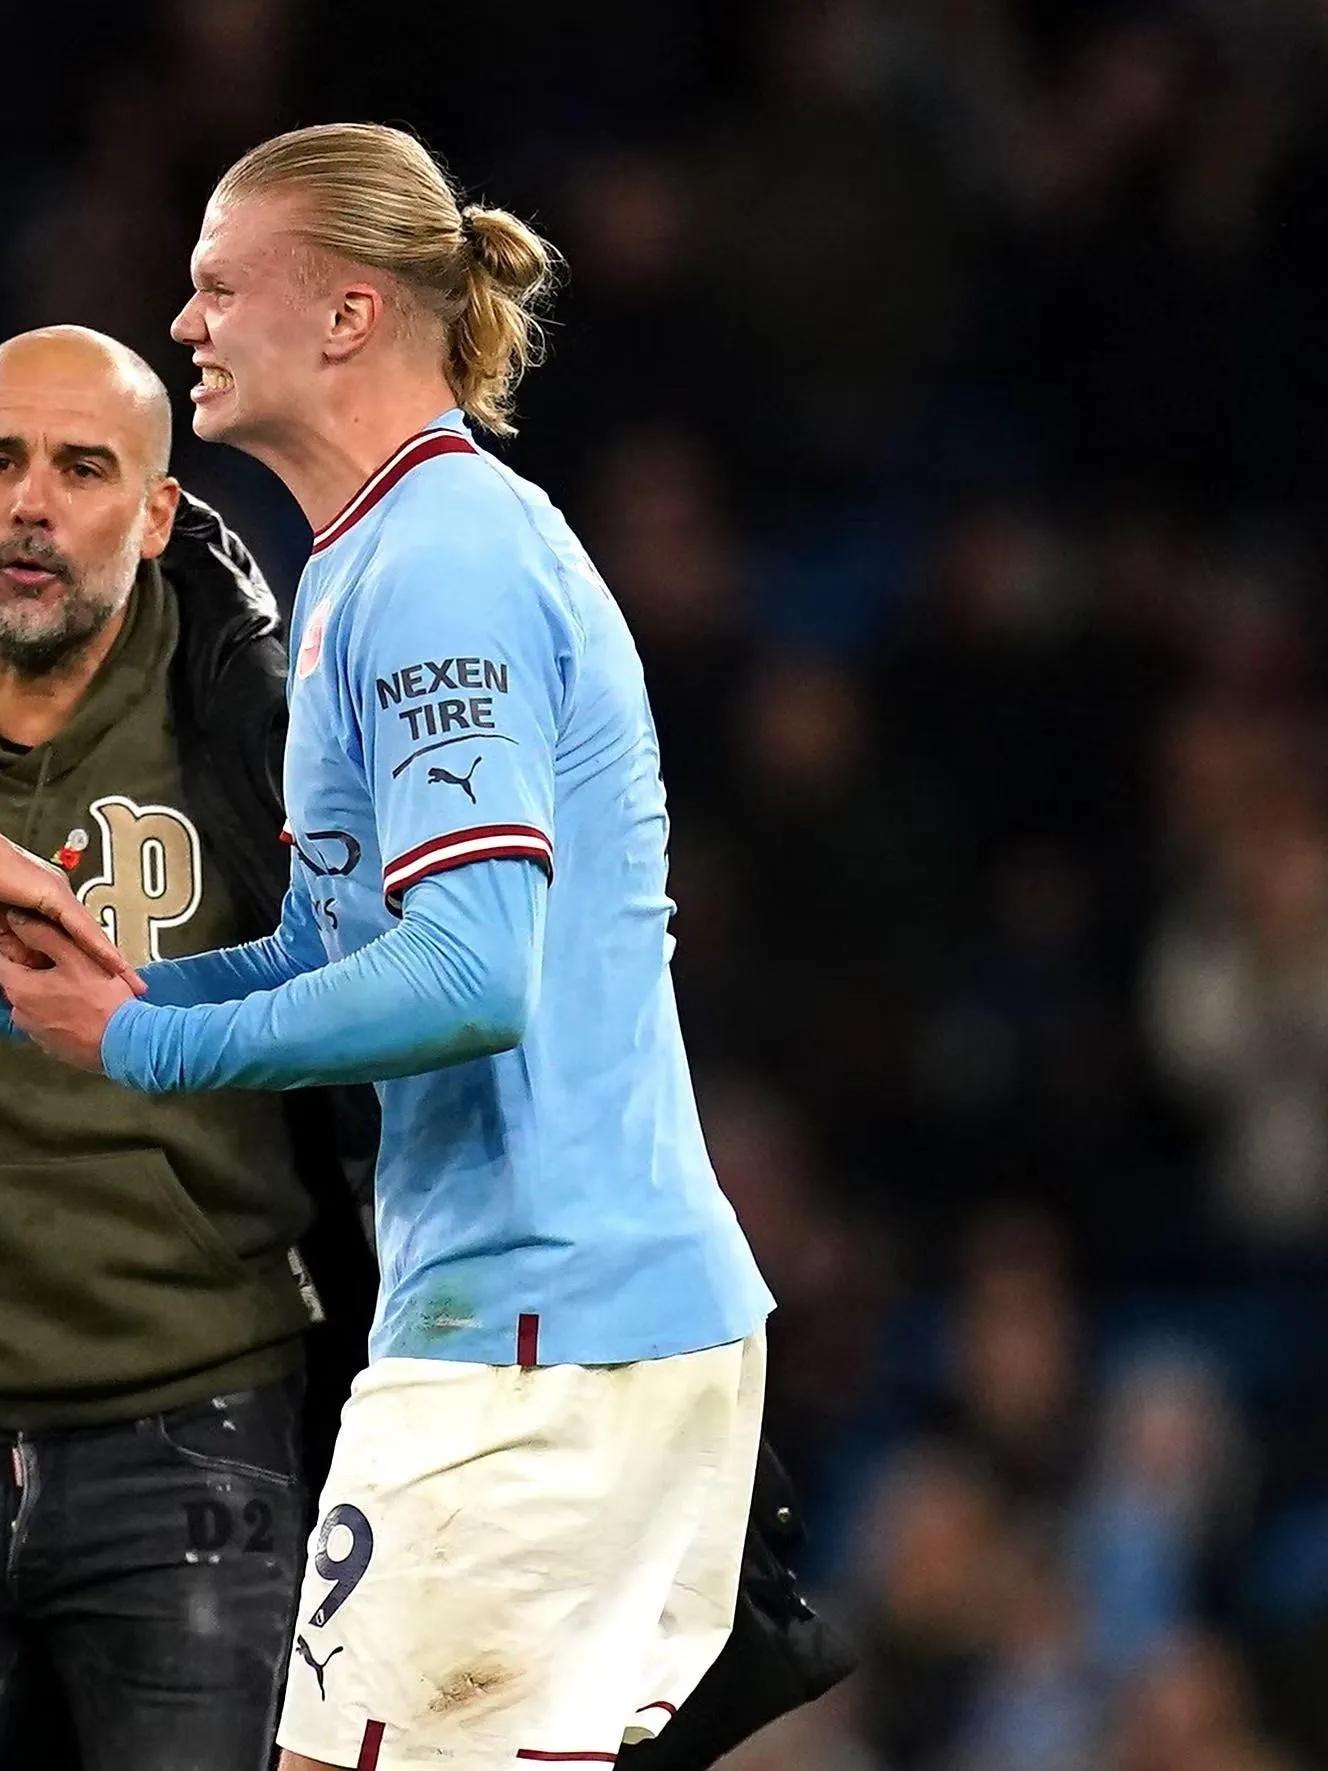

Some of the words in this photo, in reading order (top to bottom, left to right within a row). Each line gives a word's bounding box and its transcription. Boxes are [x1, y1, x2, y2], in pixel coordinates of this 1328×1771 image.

[376, 657, 509, 710] NEXEN
[399, 697, 496, 740] TIRE
[308, 1503, 374, 1628] 9
